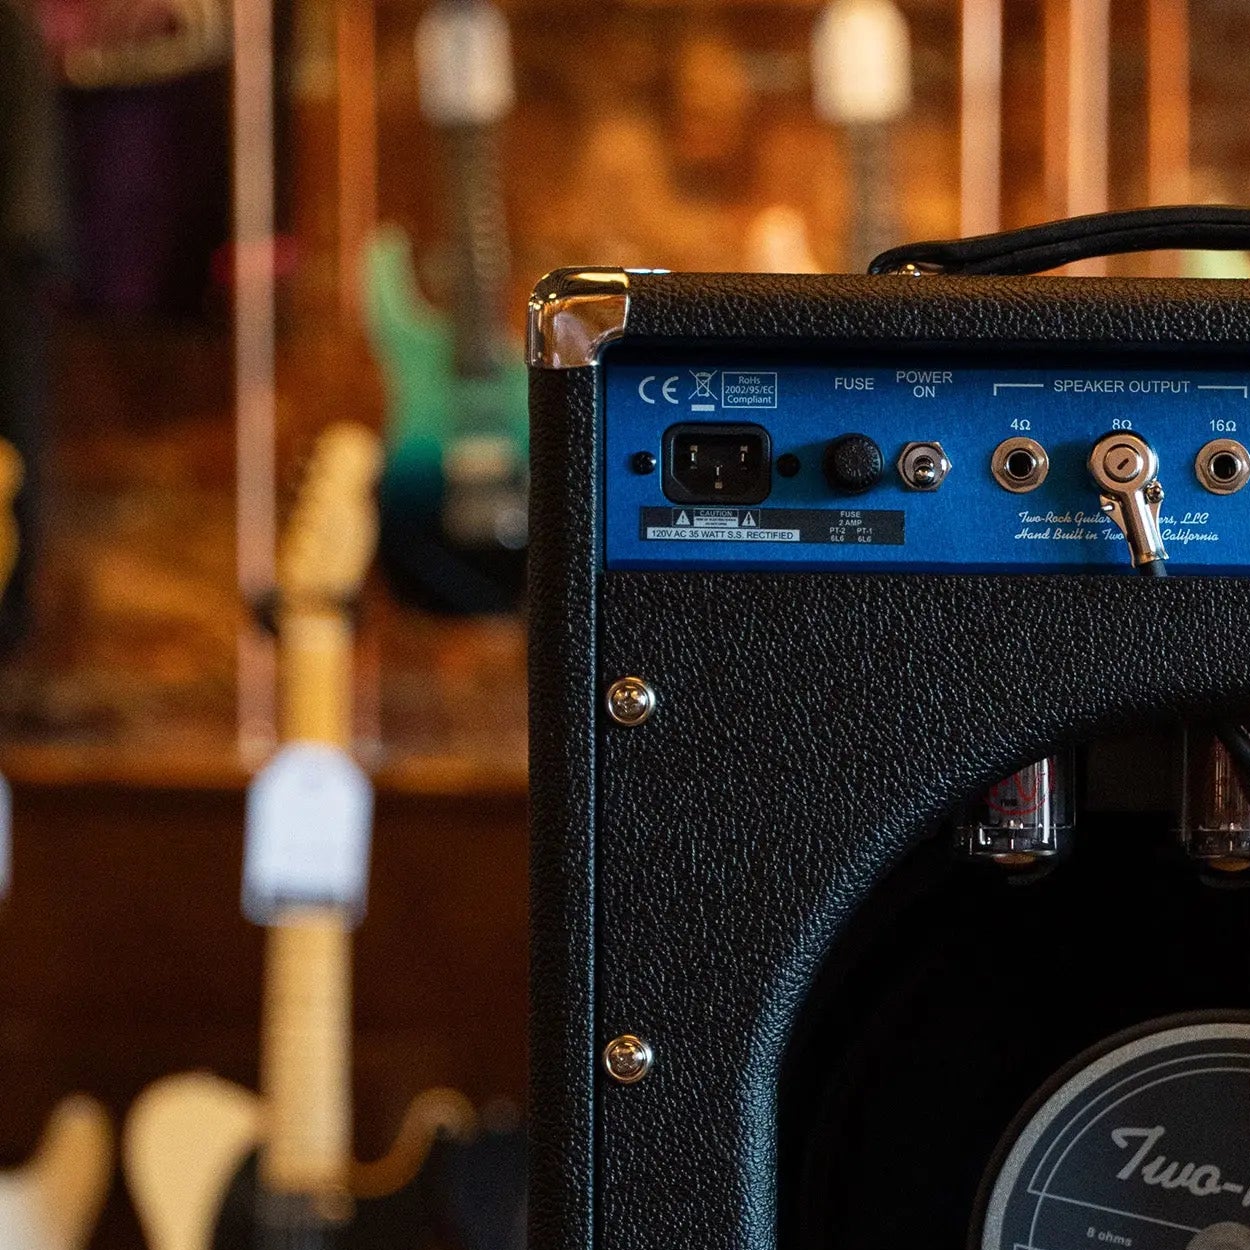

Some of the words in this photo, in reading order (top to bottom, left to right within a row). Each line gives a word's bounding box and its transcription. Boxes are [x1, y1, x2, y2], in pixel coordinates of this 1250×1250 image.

[738, 376, 761, 385] RoHs
[834, 377, 875, 390] FUSE
[896, 370, 953, 384] POWER
[638, 375, 679, 405] CE
[724, 385, 775, 396] 2002/95/EC
[913, 385, 936, 398] ON
[1053, 380, 1125, 393] SPEAKER
[1128, 380, 1191, 394] OUTPUT
[727, 395, 772, 405] Compliant
[1010, 418, 1031, 431] 4Ω
[1209, 419, 1237, 432] 16Ω
[845, 519, 863, 527] AMP
[1018, 510, 1072, 523] Two-Rock
[1074, 511, 1111, 526] Guitar
[1180, 512, 1210, 525] LLC
[652, 530, 673, 538] 120V
[674, 530, 687, 538] AC
[689, 530, 699, 538] 35
[701, 530, 726, 539] WATT
[727, 531, 743, 539] S.S.
[746, 531, 794, 540] RECTIFIED
[856, 527, 873, 535] PT-1
[1014, 527, 1051, 540] Hand
[1052, 527, 1084, 540] Built
[1085, 530, 1099, 540] in
[1161, 528, 1219, 545] California
[1086, 1226, 1096, 1238] 8
[1098, 1231, 1132, 1247] ohms
